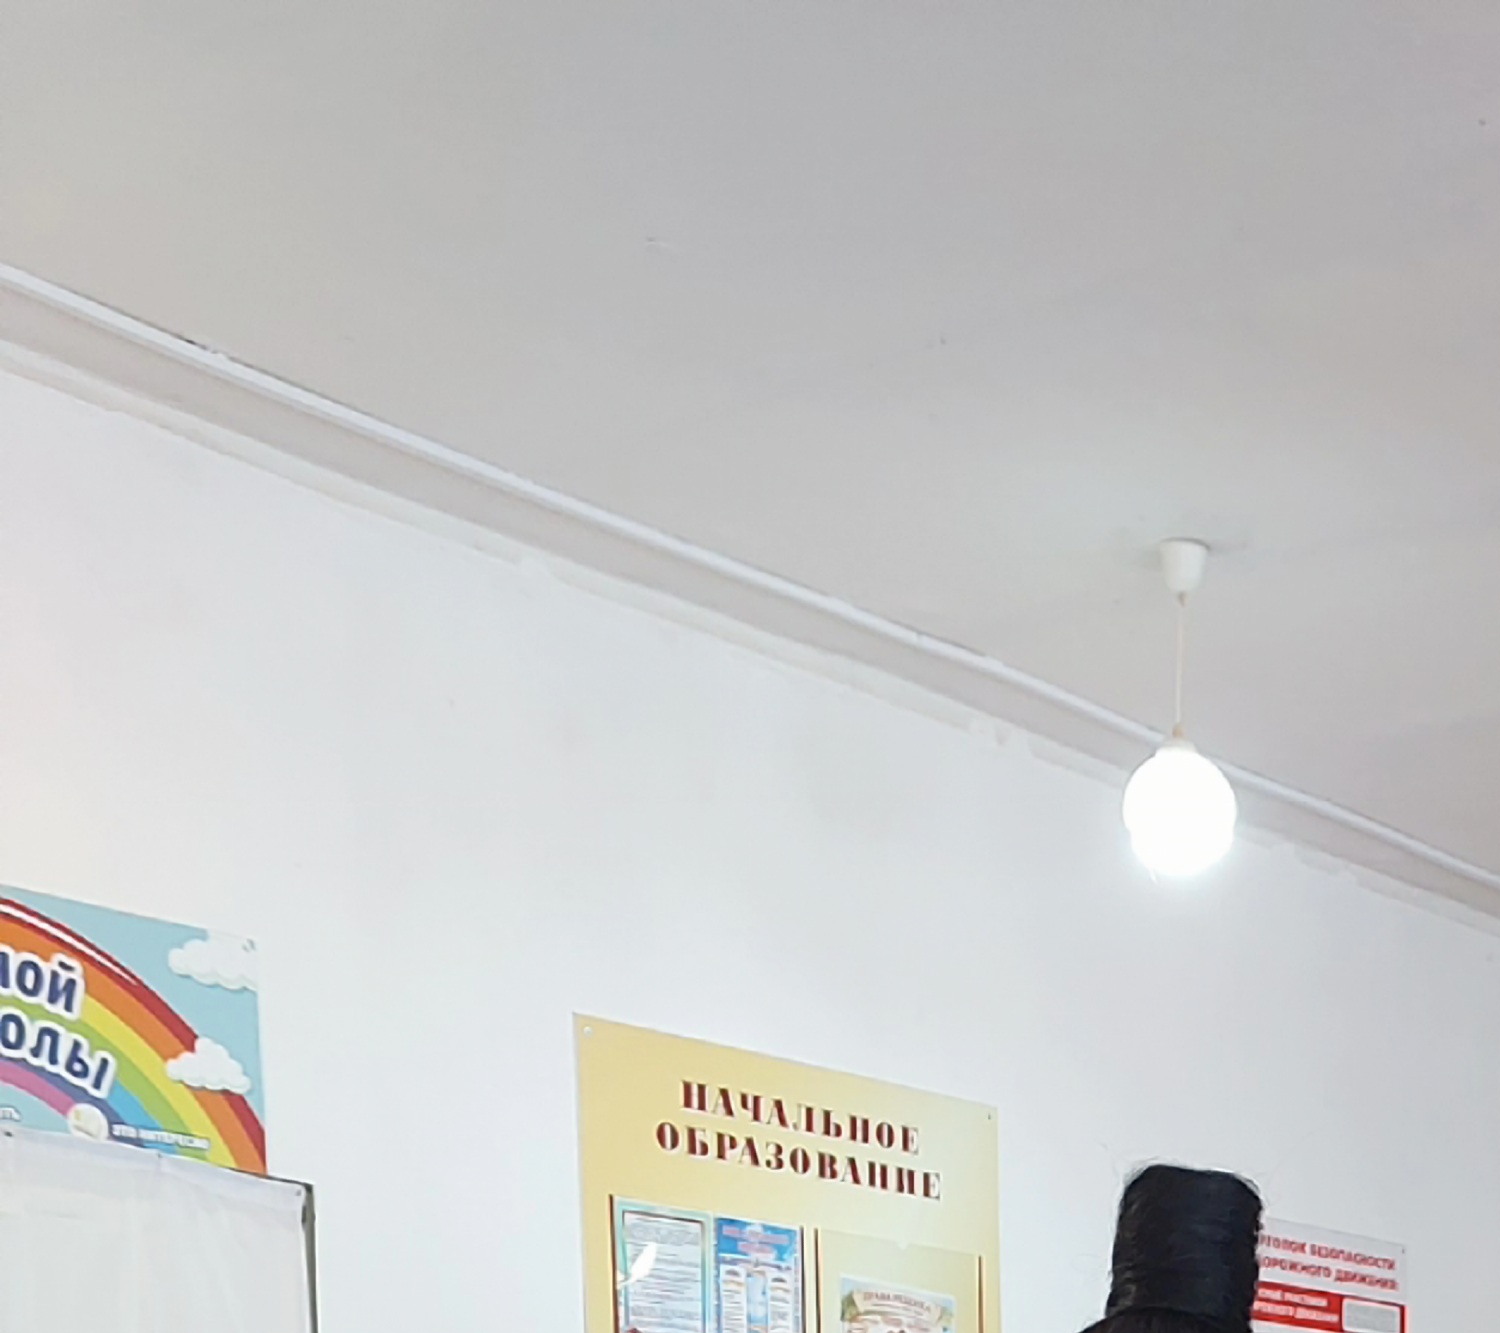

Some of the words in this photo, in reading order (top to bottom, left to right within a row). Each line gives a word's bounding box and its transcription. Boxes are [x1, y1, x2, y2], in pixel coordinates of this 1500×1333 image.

[682, 1080, 919, 1155] НАЧАЛЬНОЕ
[656, 1121, 941, 1200] ОБРАЗОВАНИЕ
[1259, 1256, 1331, 1279] ОРОЖНОГО
